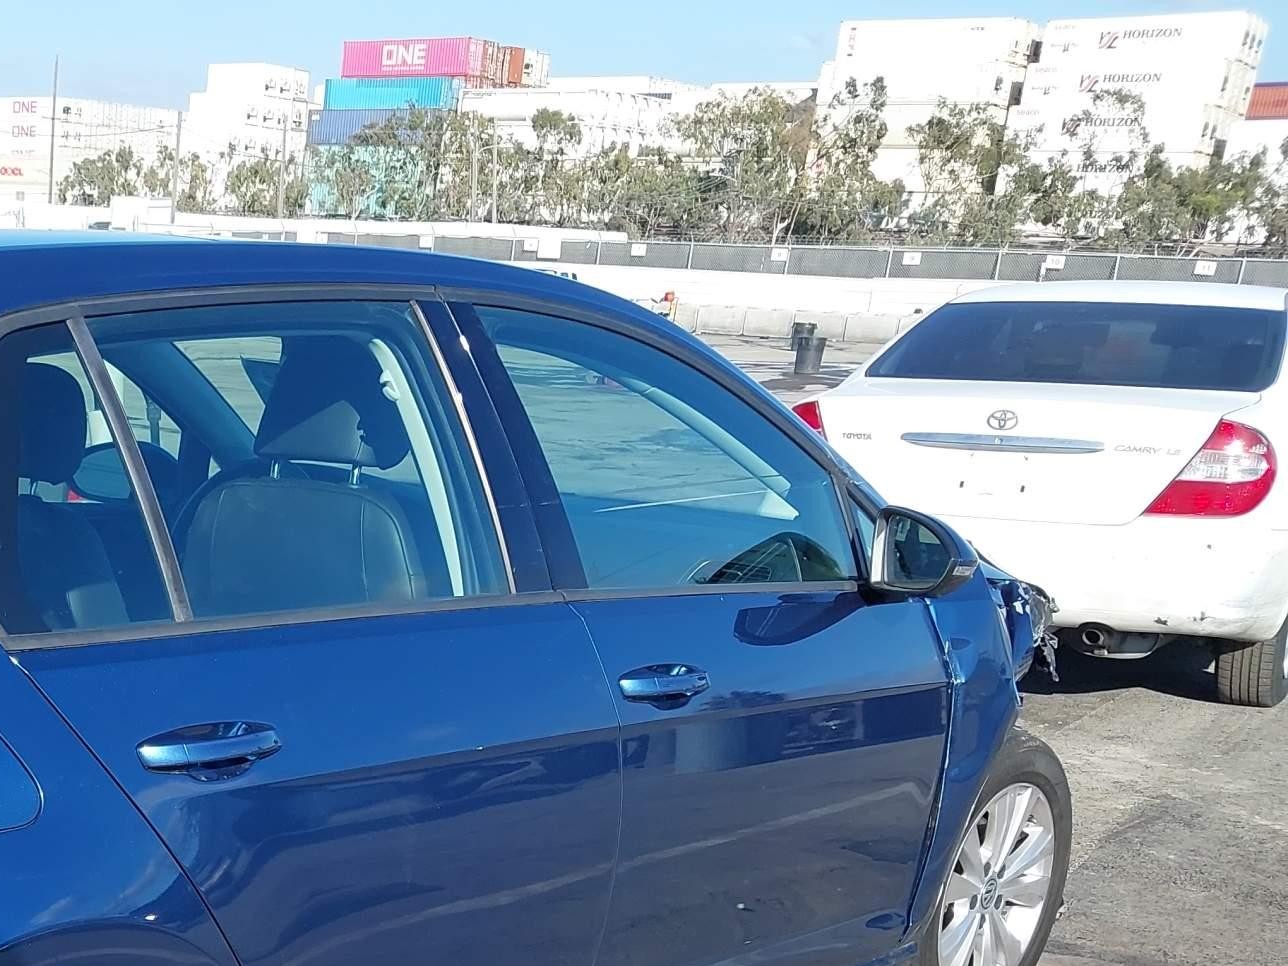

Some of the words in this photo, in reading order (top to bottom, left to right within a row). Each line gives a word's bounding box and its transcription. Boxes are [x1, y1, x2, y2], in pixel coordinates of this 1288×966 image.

[1123, 28, 1183, 39] HORIZON
[382, 44, 427, 66] ONE
[1103, 72, 1163, 83] HORIZON
[13, 101, 38, 114] ONE
[12, 125, 37, 138] ONE
[842, 432, 873, 441] TOYOTA
[1113, 444, 1161, 455] CAMRY
